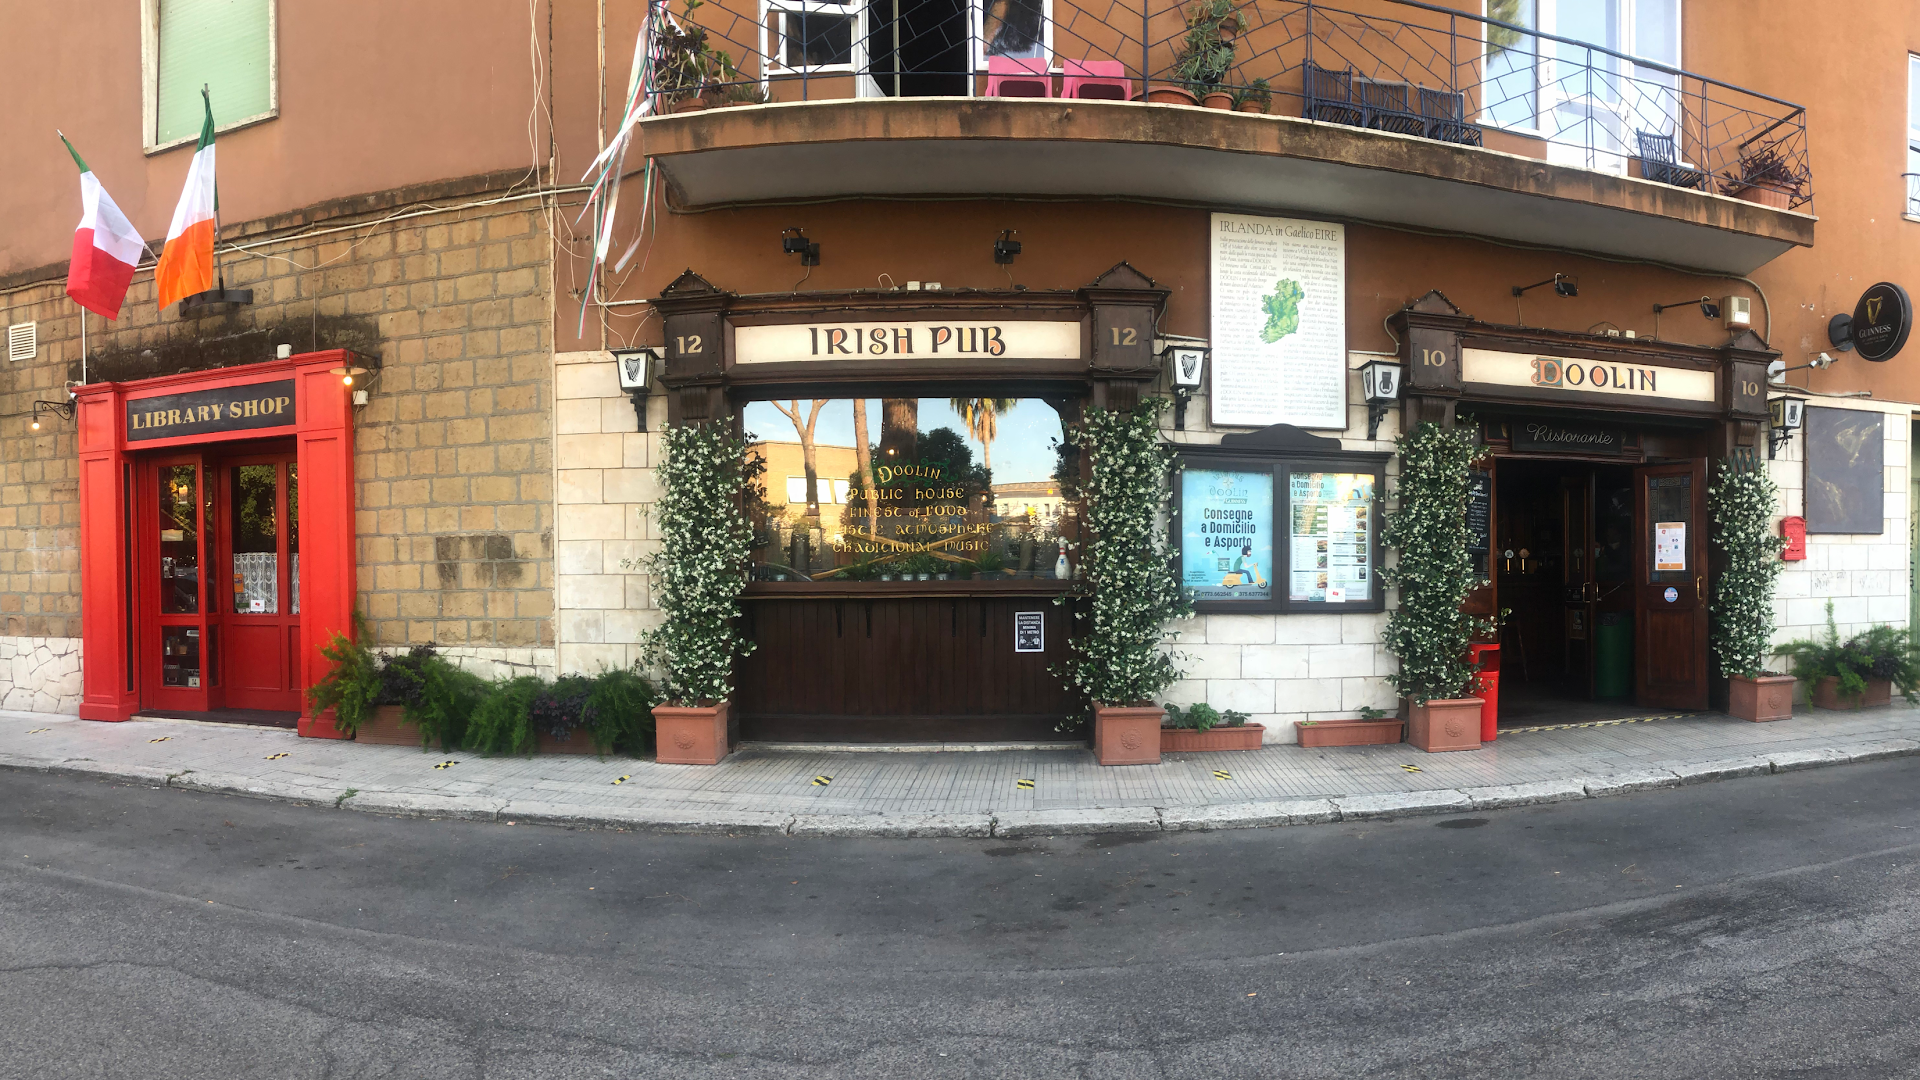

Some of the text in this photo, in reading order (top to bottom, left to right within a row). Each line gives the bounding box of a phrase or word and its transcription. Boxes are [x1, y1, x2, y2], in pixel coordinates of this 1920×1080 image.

[1220, 220, 1274, 236] IRLANDA
[1275, 225, 1283, 237] in
[1285, 225, 1314, 240] Gaelico
[1315, 228, 1338, 242] EIRE
[808, 325, 1007, 356] IRISH PUB
[1110, 327, 1138, 346] 12
[1858, 324, 1892, 339] GUINNESS
[676, 335, 703, 354] 12
[1422, 349, 1446, 367] 10
[1531, 356, 1658, 392] DOOLIN
[1741, 380, 1759, 396] 10
[132, 396, 290, 430] LIBRARY SHOP
[1526, 423, 1614, 445] Ristorante
[877, 465, 941, 484] DOOLIN
[1297, 480, 1325, 489] Domicilio
[850, 488, 903, 500] PUBLIC
[1299, 489, 1322, 499] Asporto
[1204, 507, 1253, 524] Consegne
[1201, 521, 1256, 534] a Domicilio
[1205, 536, 1252, 551] e Asporto
